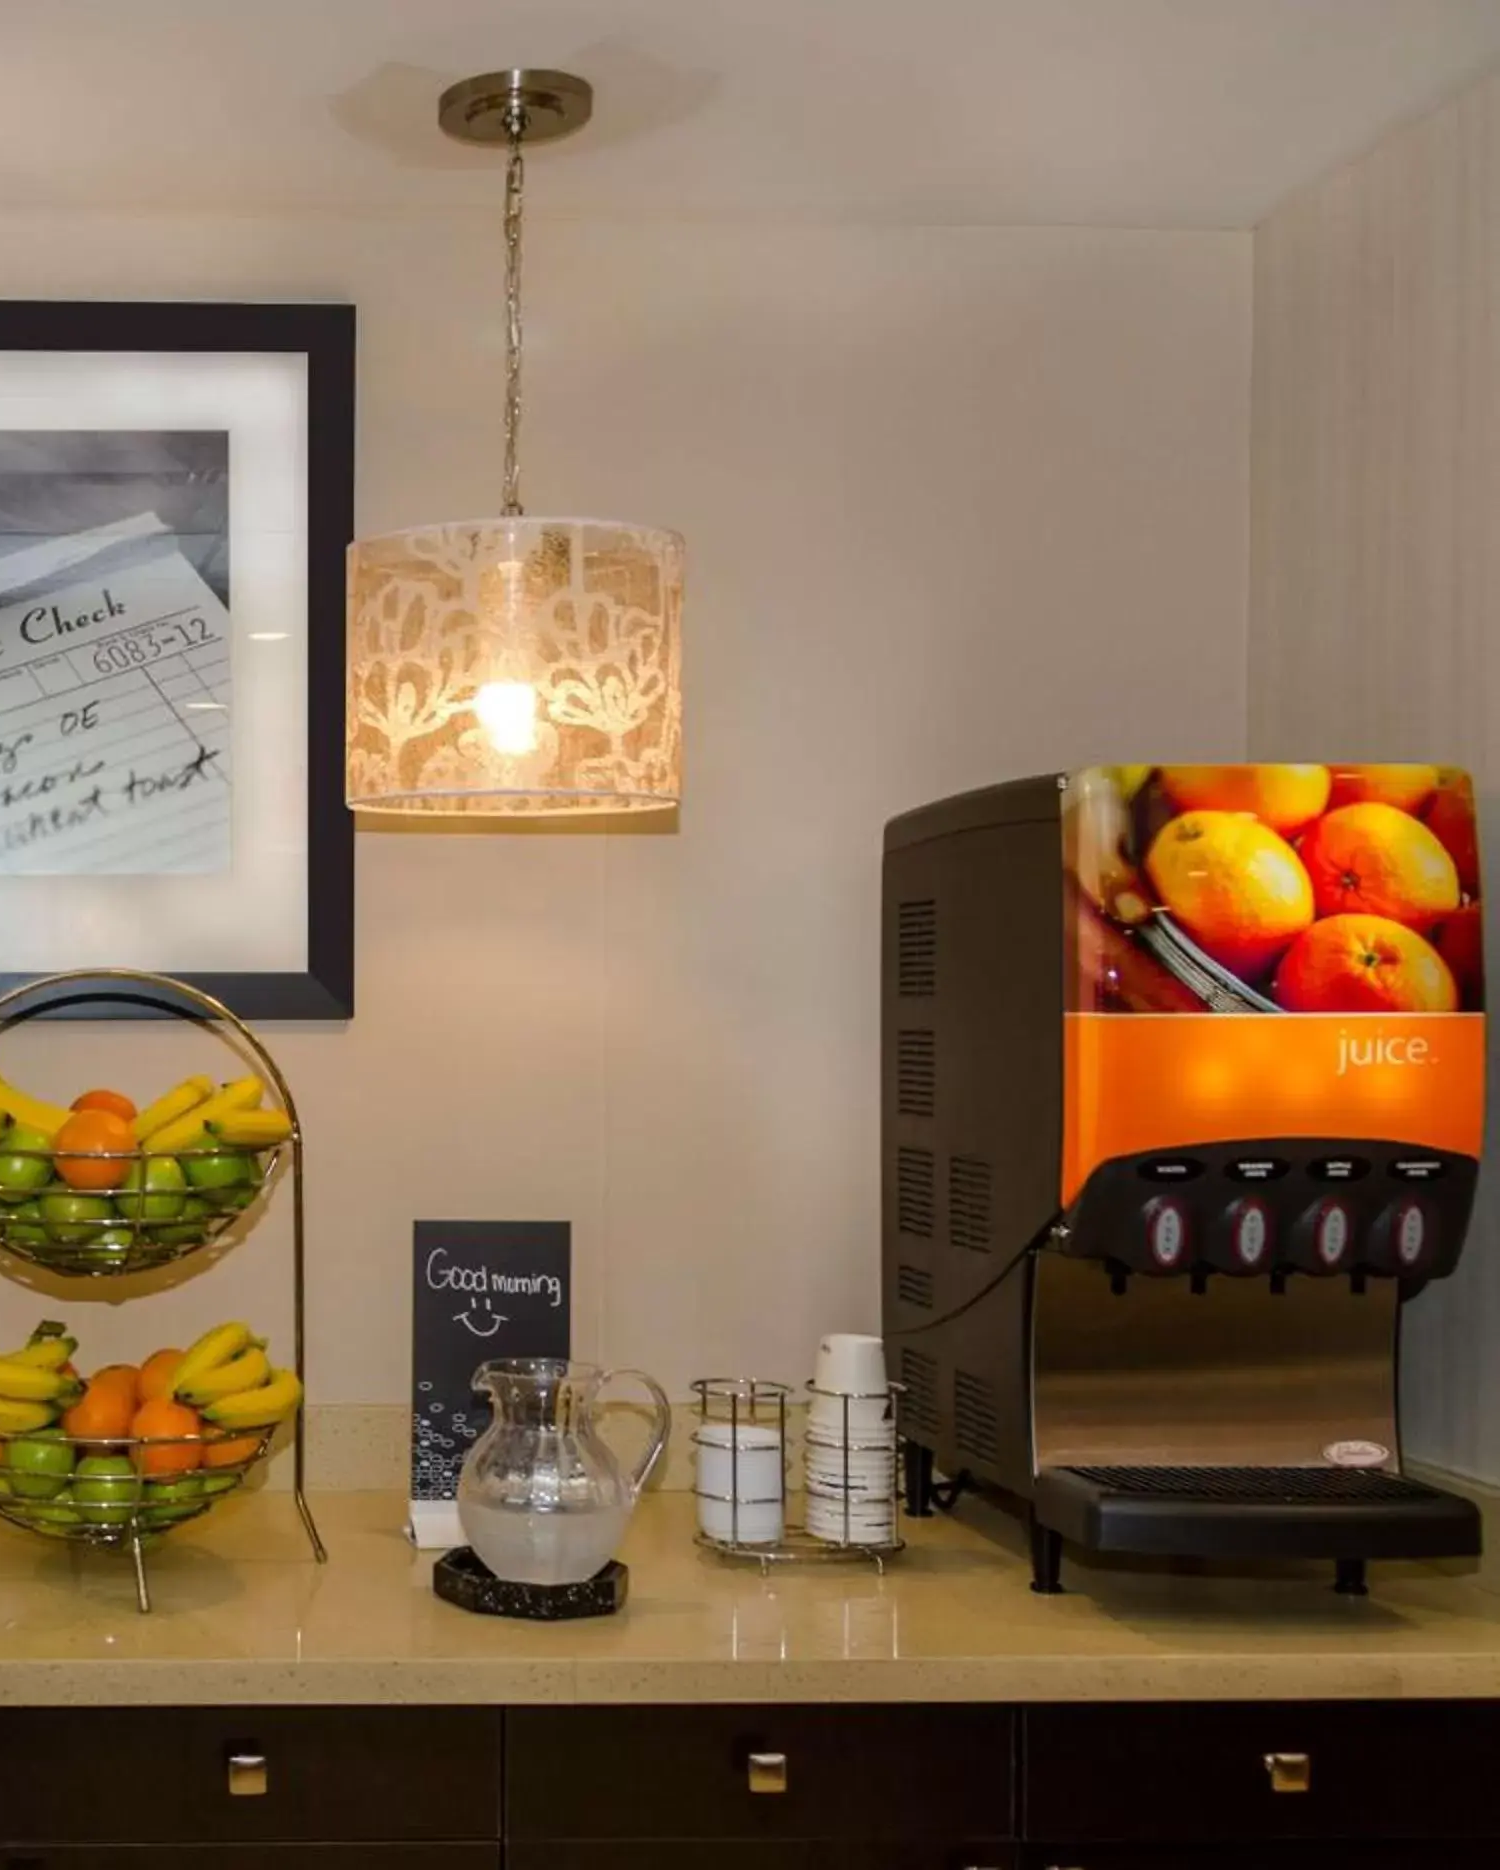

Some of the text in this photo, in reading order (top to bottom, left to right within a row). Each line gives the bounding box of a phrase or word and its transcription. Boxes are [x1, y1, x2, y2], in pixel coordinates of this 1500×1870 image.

[19, 588, 127, 645] Check
[92, 616, 215, 675] 6083-12
[426, 1247, 488, 1293] Good
